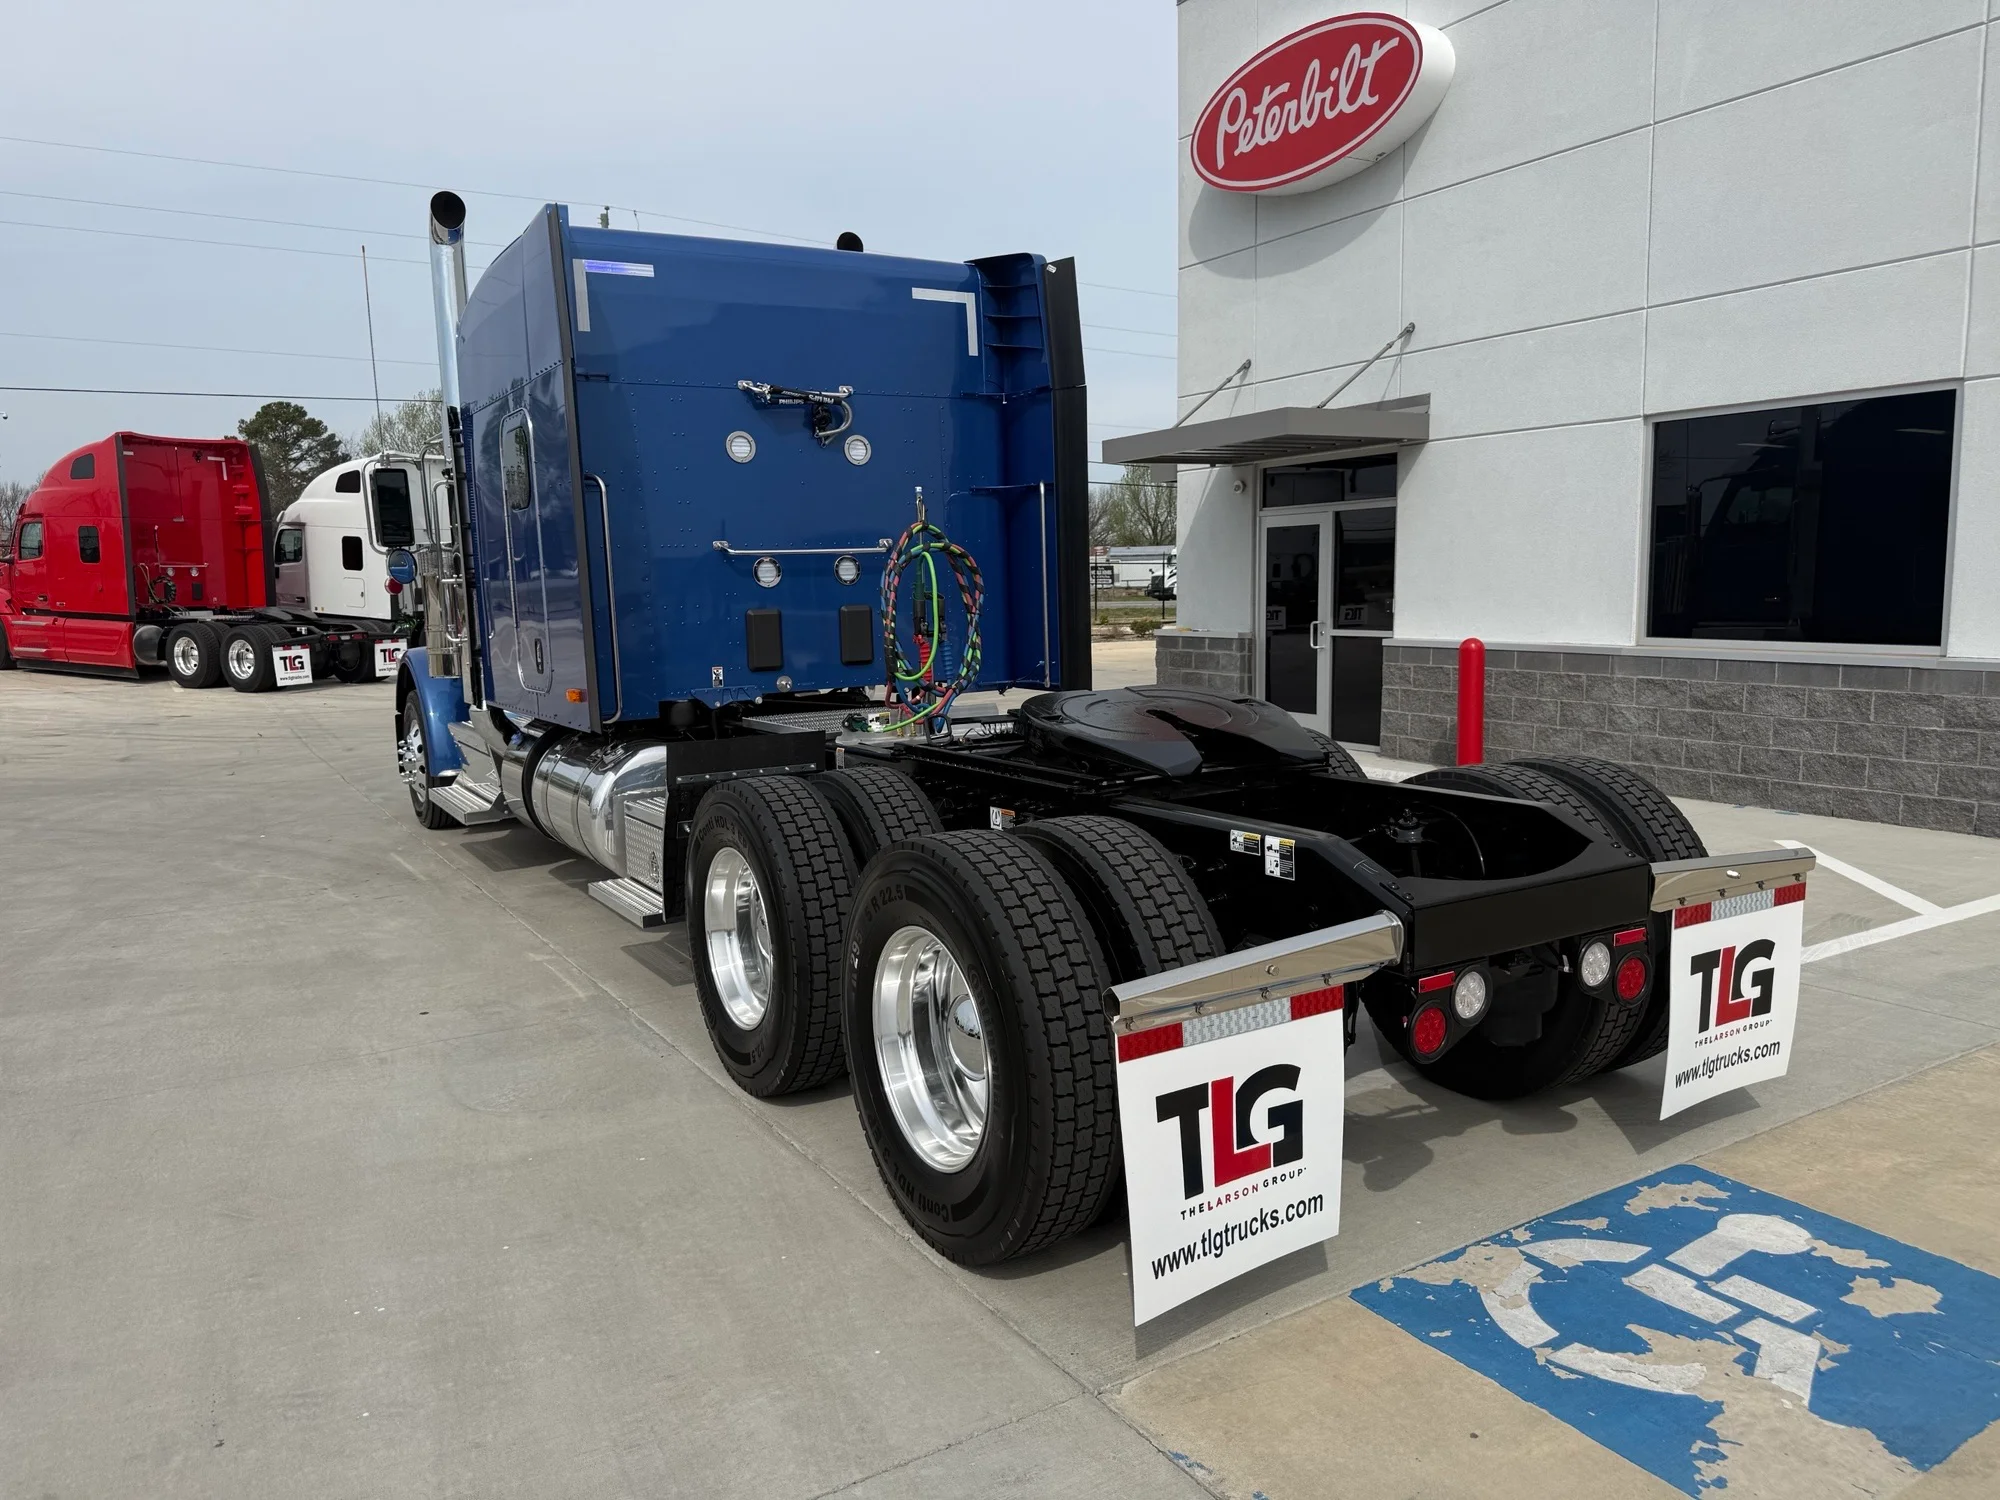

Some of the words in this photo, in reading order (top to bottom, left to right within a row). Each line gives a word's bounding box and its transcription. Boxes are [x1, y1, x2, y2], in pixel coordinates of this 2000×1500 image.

[1216, 36, 1400, 170] Peterbilt
[279, 655, 305, 671] TLG
[879, 883, 905, 908] 22.5
[1690, 938, 1776, 1034] TLG
[1742, 1019, 1771, 1033] GROUP
[1675, 1040, 1781, 1089] www.tlgtrucks.com
[1155, 1063, 1304, 1200] TLG
[1263, 1168, 1305, 1189] GROUP
[1151, 1193, 1324, 1280] www.tlgtrucks.com
